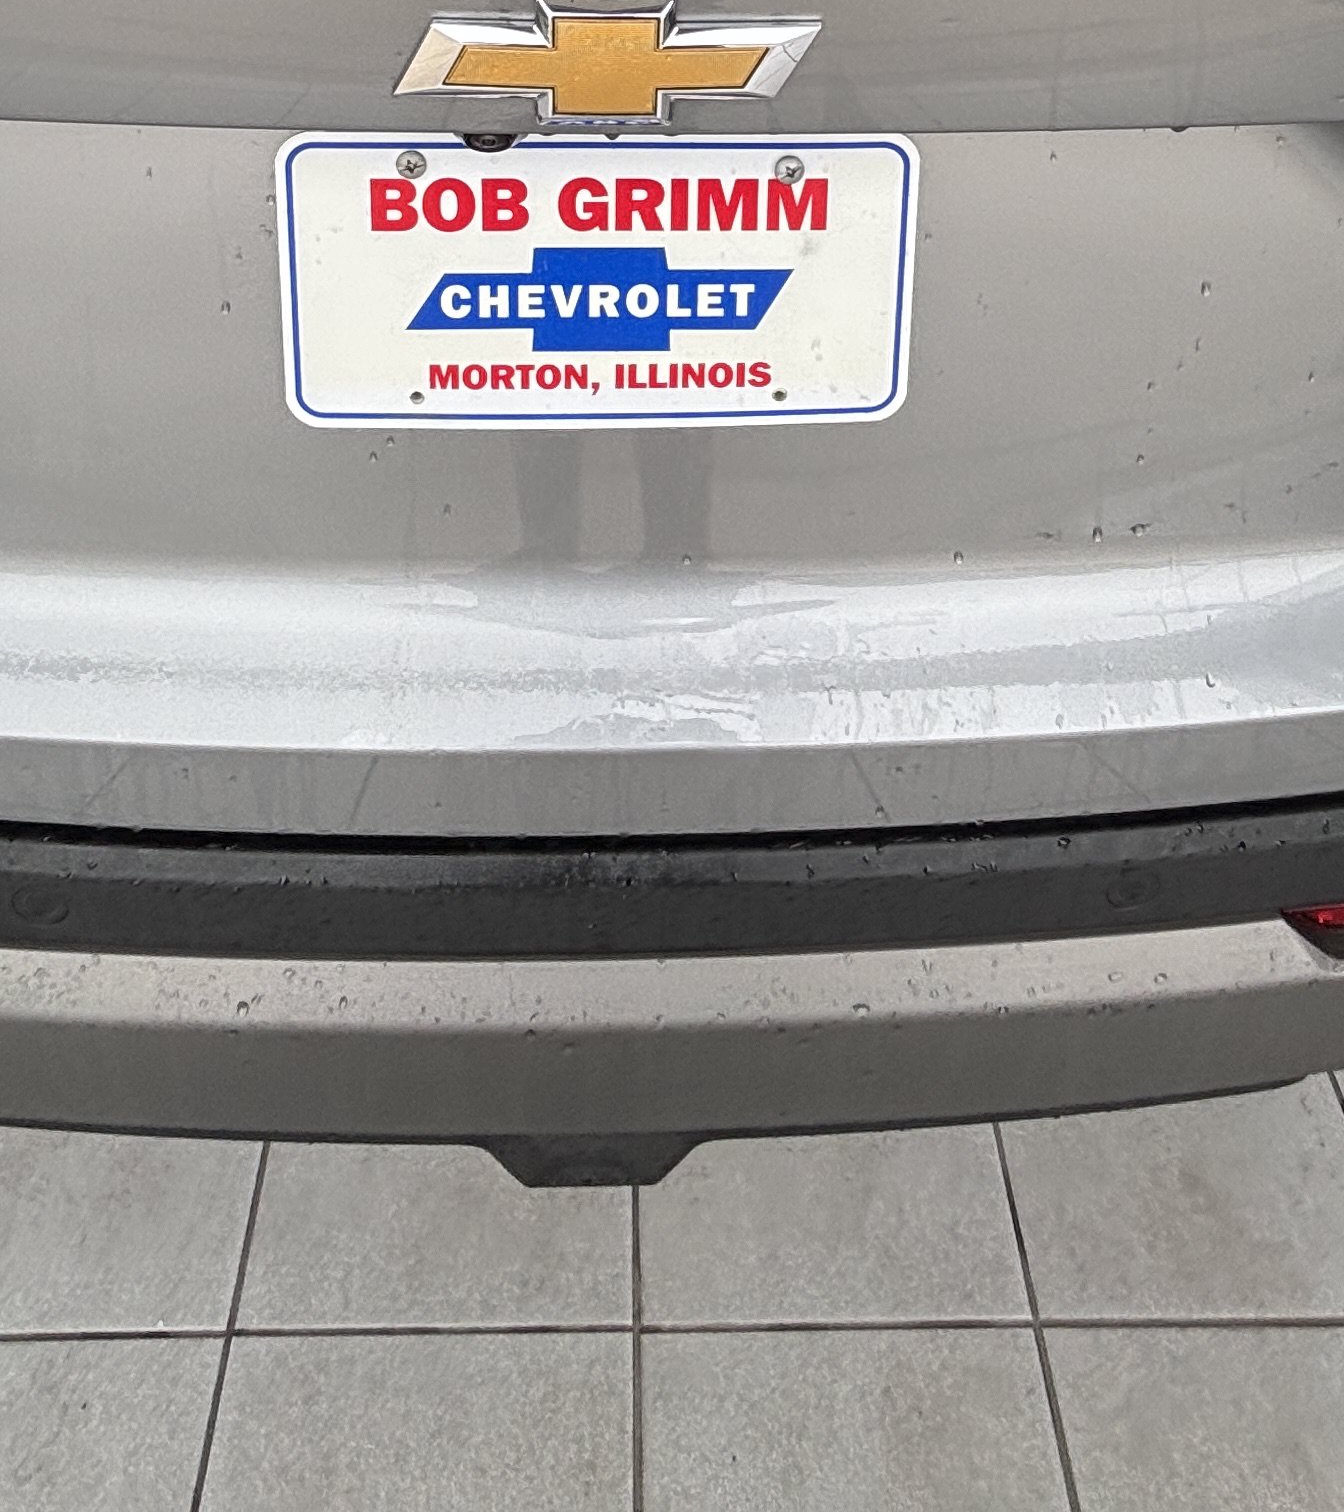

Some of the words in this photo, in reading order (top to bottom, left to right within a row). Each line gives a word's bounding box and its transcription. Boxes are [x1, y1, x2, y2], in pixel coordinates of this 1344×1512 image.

[369, 178, 529, 232] BOB
[558, 177, 829, 232] GRIMM
[439, 284, 756, 319] CHEVROLET
[429, 363, 600, 395] MORTON,
[614, 362, 772, 389] ILLINOIS
